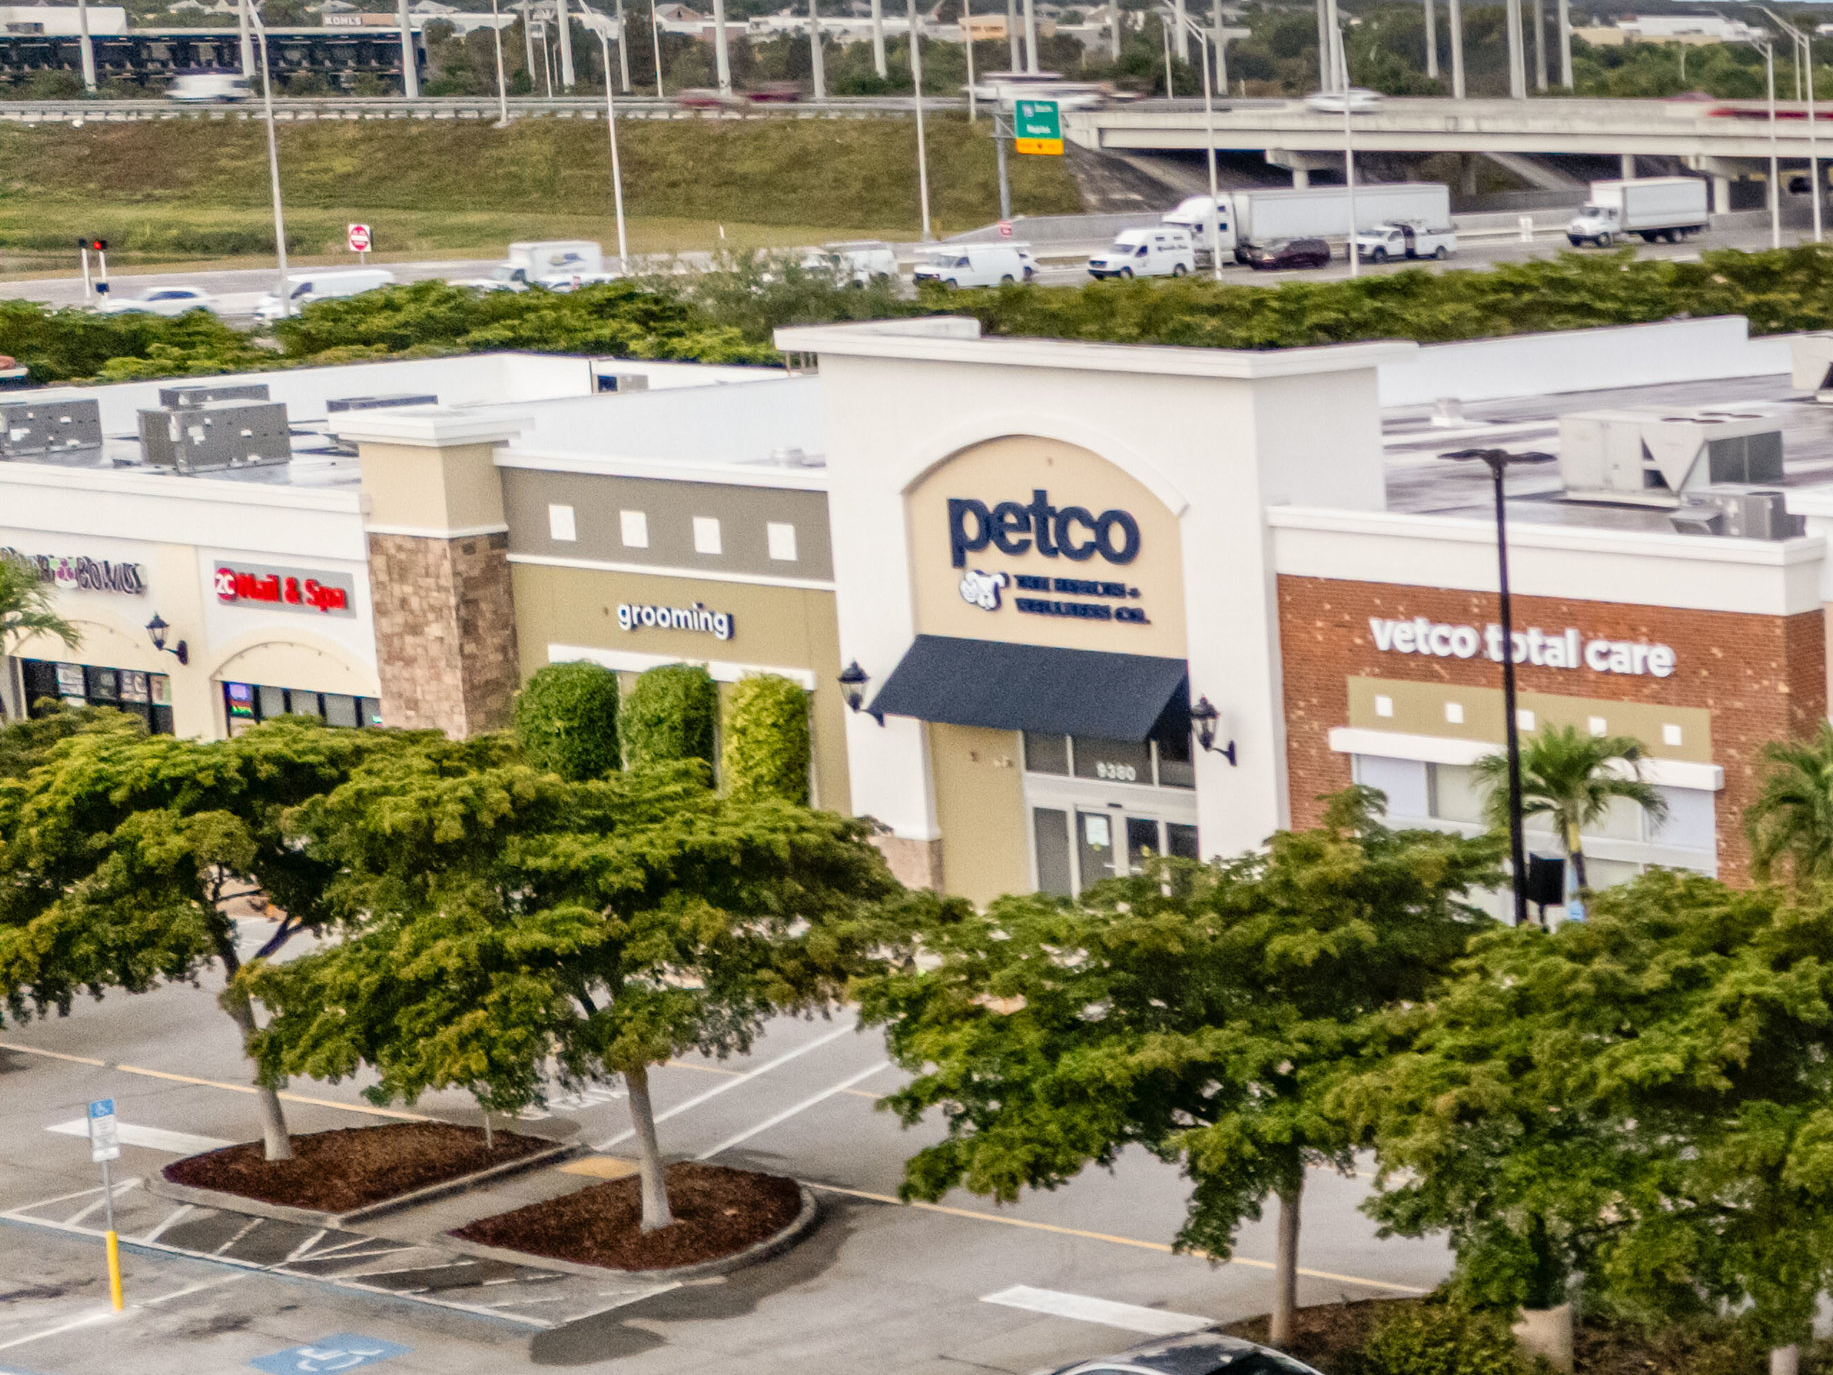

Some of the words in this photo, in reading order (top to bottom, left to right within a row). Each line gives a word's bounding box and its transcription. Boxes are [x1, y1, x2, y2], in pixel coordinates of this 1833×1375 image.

[947, 489, 1140, 568] petco
[236, 572, 280, 602] Nail
[282, 576, 302, 604] &
[303, 579, 347, 612] Spa
[617, 602, 731, 640] grooming
[1369, 617, 1480, 658] vetco
[1484, 622, 1580, 668] total
[1586, 639, 1675, 678] care
[1096, 761, 1136, 782] 9380
